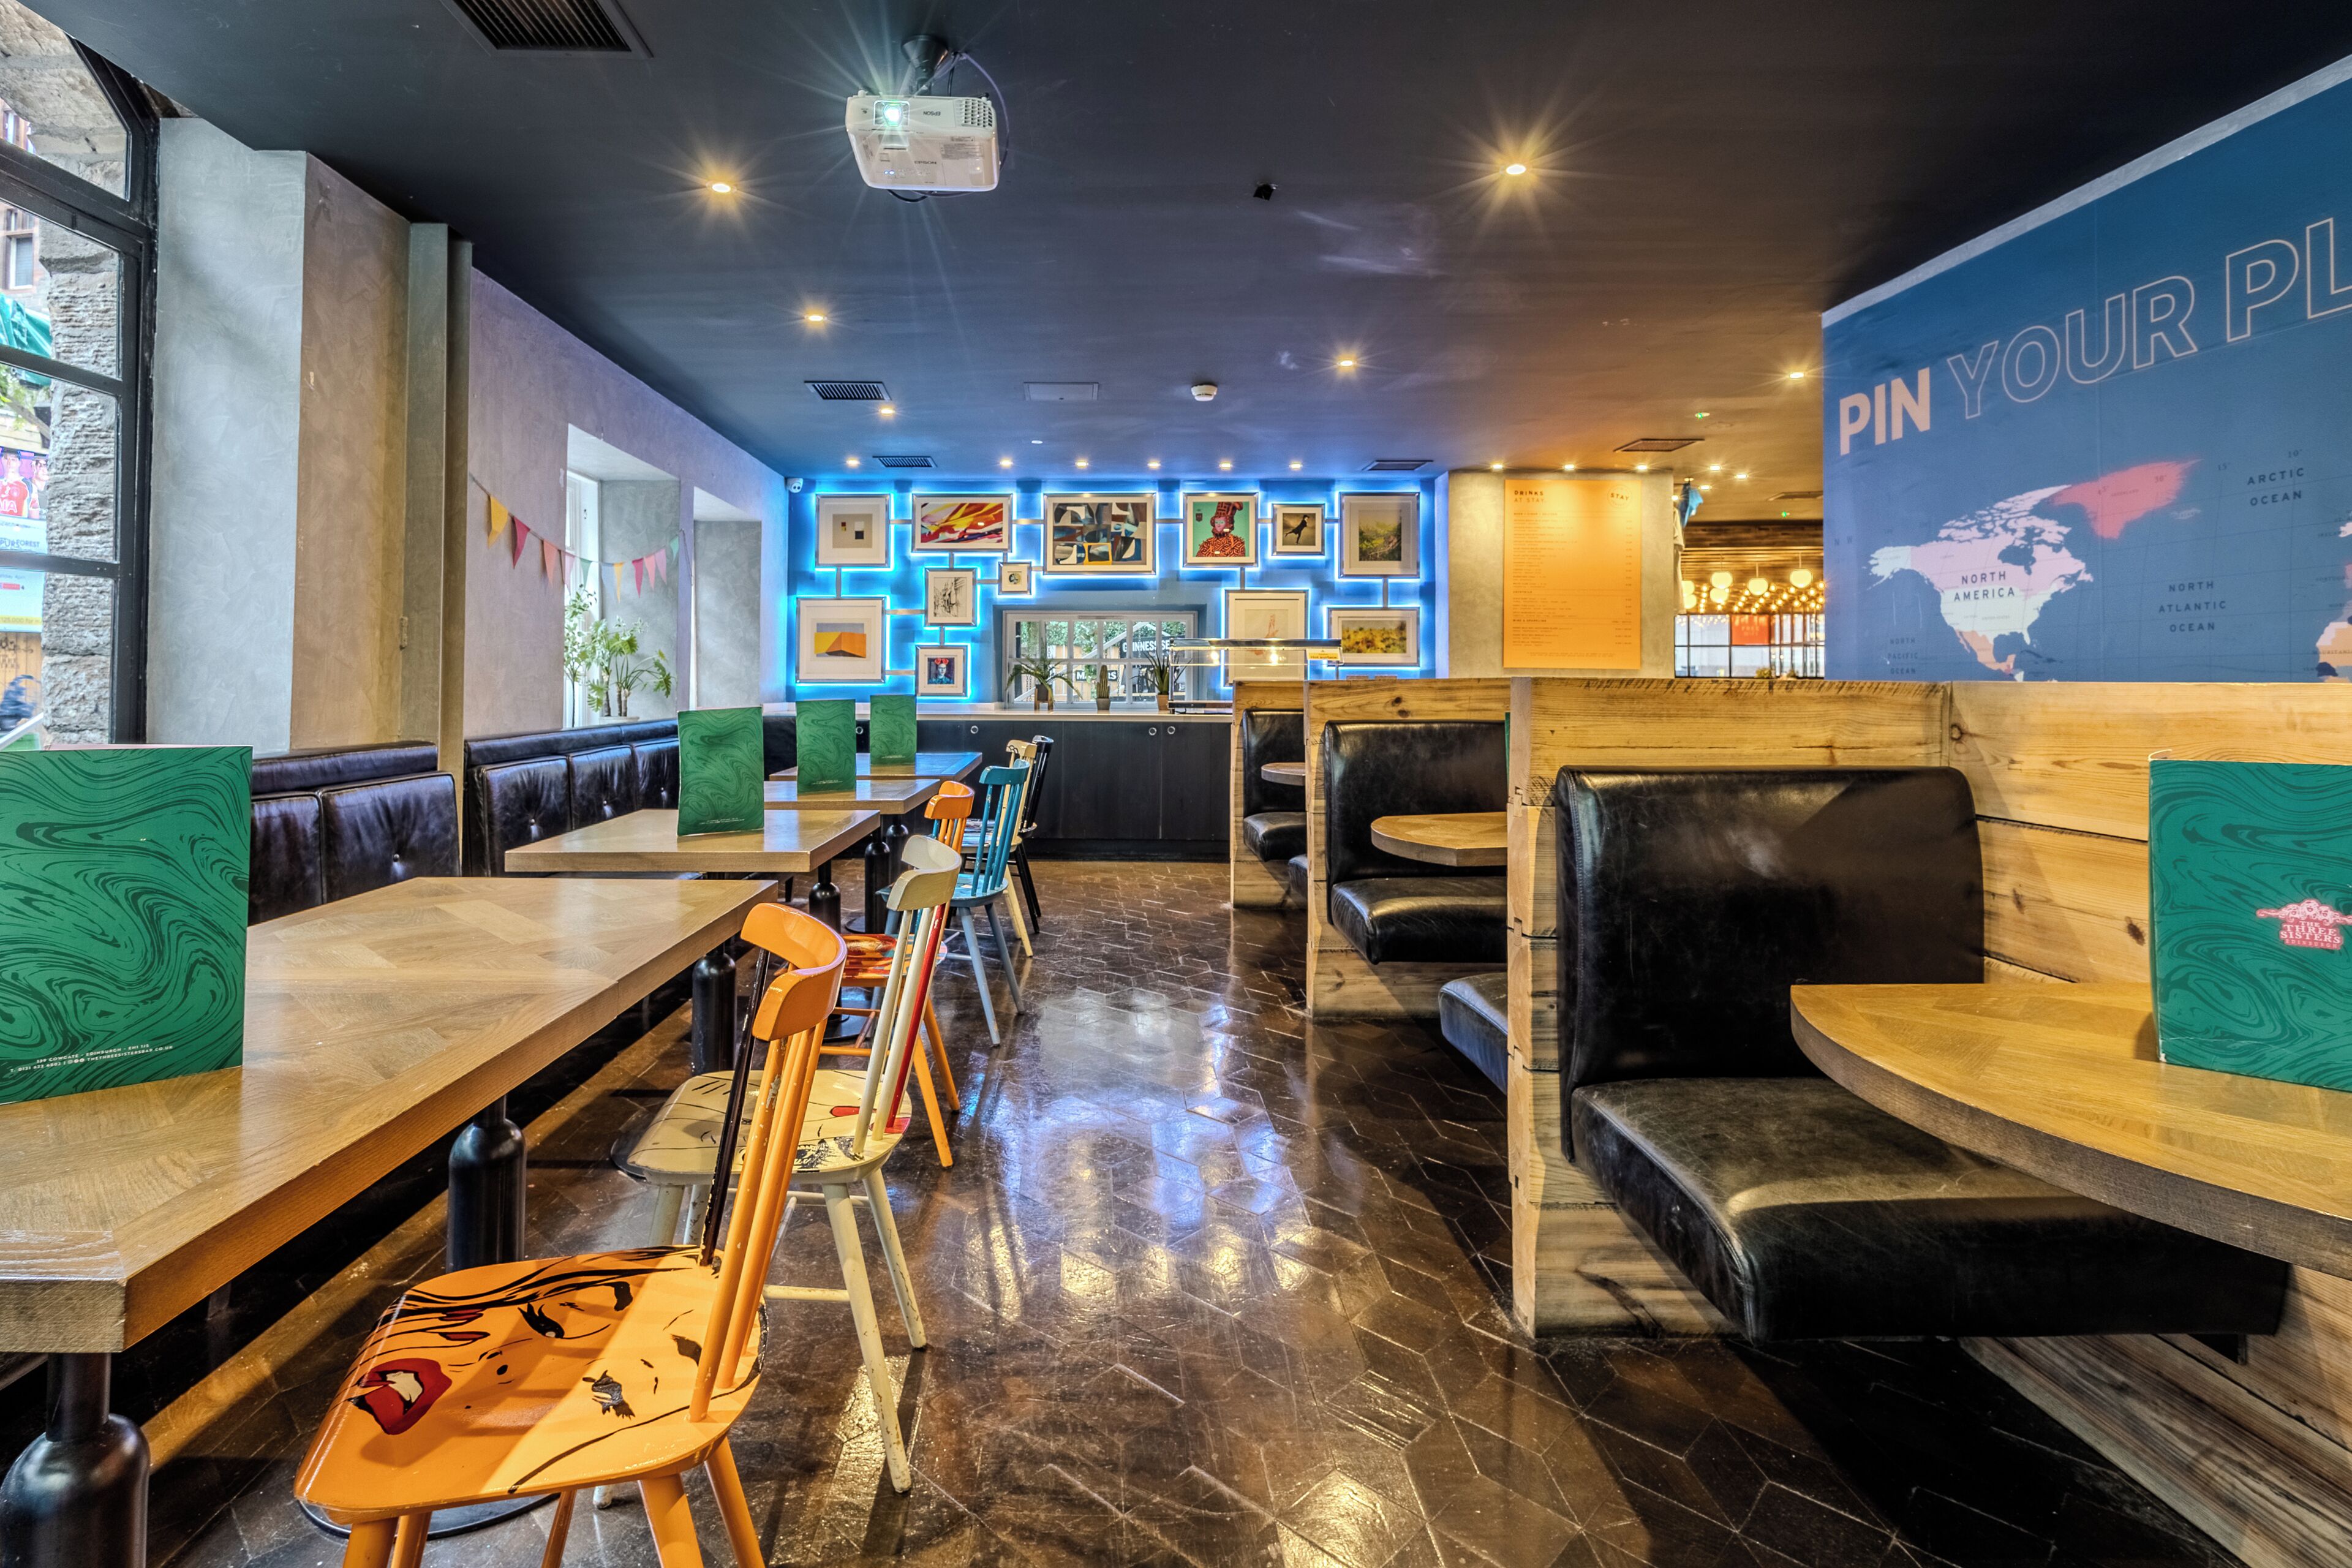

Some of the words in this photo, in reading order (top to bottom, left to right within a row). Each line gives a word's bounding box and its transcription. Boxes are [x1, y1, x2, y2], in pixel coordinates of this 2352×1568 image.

[1839, 367, 1931, 456] PIN
[1947, 275, 2198, 420] YOUR
[2247, 467, 2305, 485] ARCTIC
[1610, 492, 1630, 501] STAY
[2250, 491, 2302, 507] OCEAN
[1961, 571, 2006, 585] NORTH
[2168, 581, 2214, 592] NORTH
[1953, 587, 2015, 602] AMERICA
[2158, 600, 2226, 613] ATLANTIC
[2169, 622, 2215, 633] OCEAN
[1122, 640, 1156, 652] GINNESS
[2283, 924, 2337, 937] THREE
[2280, 931, 2341, 944] SISTERS
[2285, 938, 2339, 949] EDINBURGH
[86, 1048, 122, 1057] EDINBURGH
